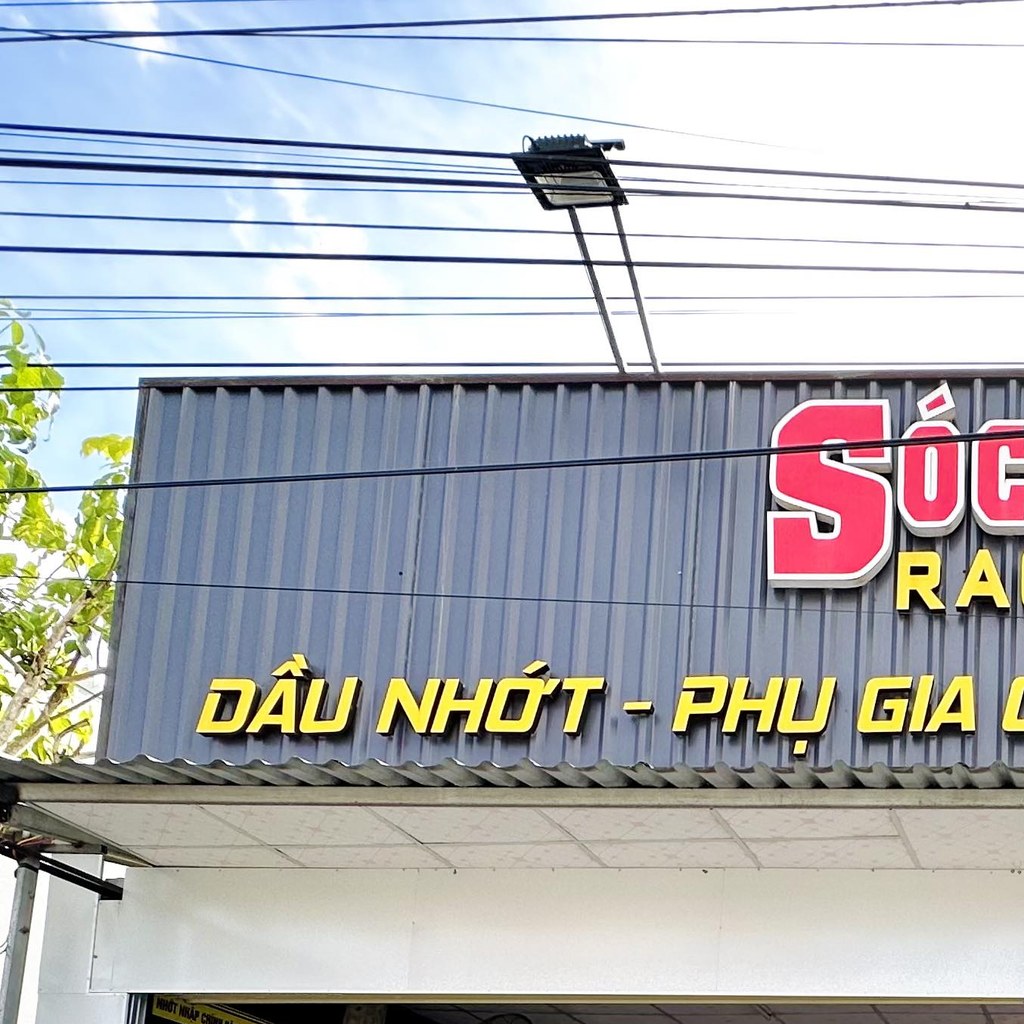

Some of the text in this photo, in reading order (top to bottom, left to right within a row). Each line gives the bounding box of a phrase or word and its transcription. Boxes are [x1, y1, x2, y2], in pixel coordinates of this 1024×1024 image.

[196, 653, 358, 733] DẦU
[376, 660, 604, 733] NHỚT
[673, 674, 835, 754] PHỤ
[856, 674, 976, 733] GIA
